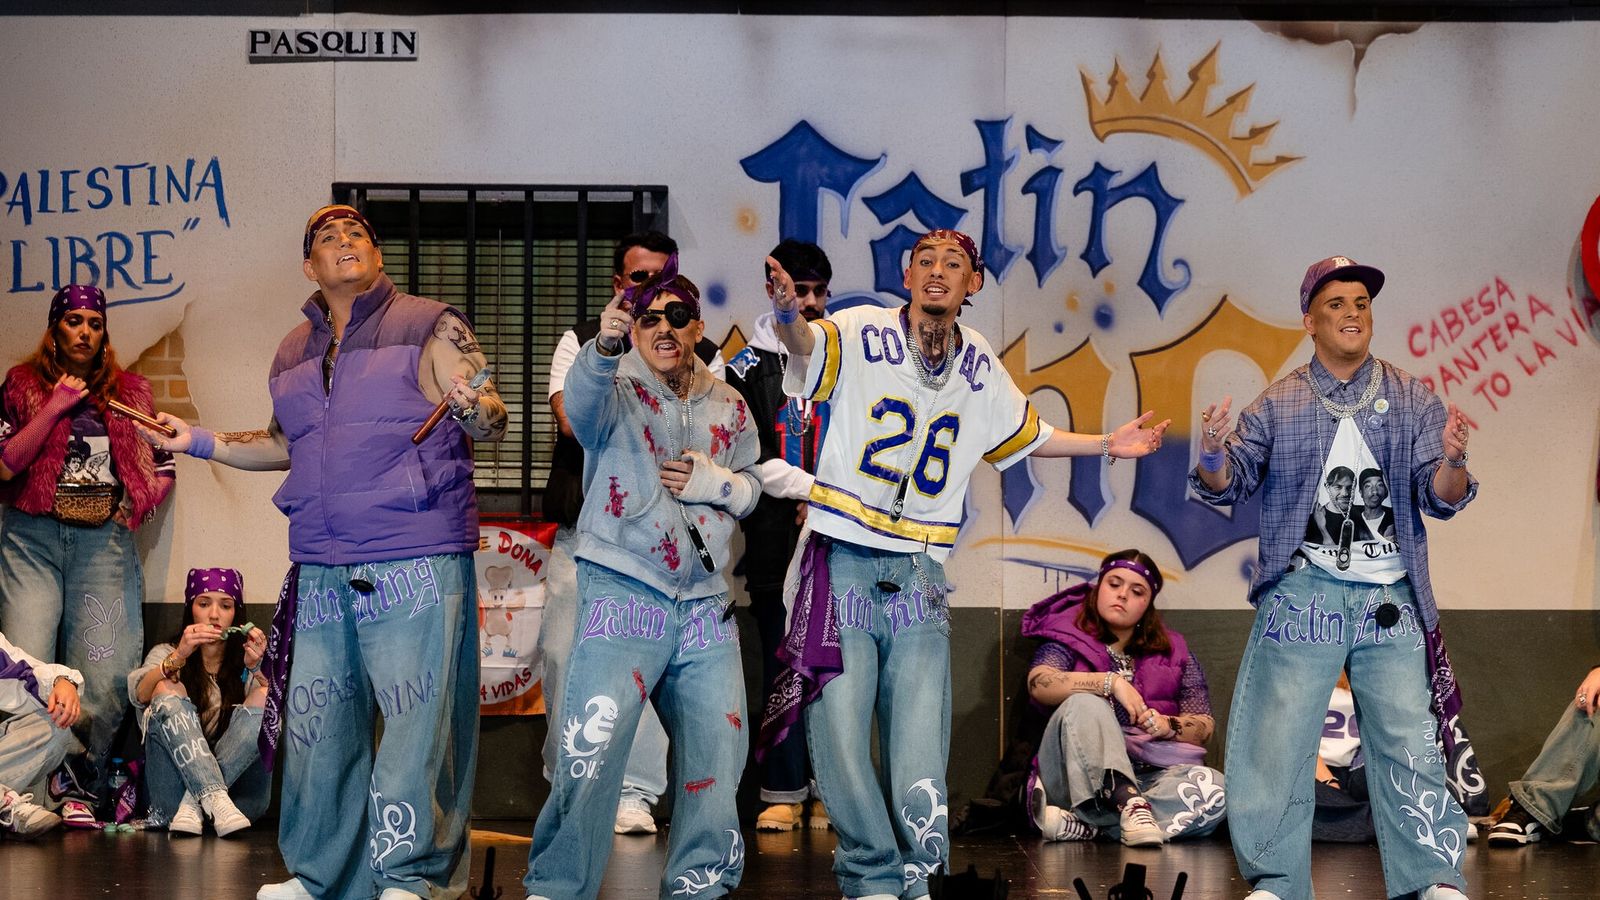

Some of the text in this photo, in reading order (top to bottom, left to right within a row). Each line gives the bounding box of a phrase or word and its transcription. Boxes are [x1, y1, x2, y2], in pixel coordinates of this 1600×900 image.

[249, 29, 417, 55] PASQUIN
[1407, 275, 1515, 359] CABESA
[1515, 340, 1557, 376] LA
[856, 394, 961, 499] 26
[497, 531, 543, 576] DONA
[579, 594, 669, 647] Latin
[1259, 592, 1345, 647] Latin
[491, 667, 532, 699] VIDAS
[173, 737, 211, 768] COAC
